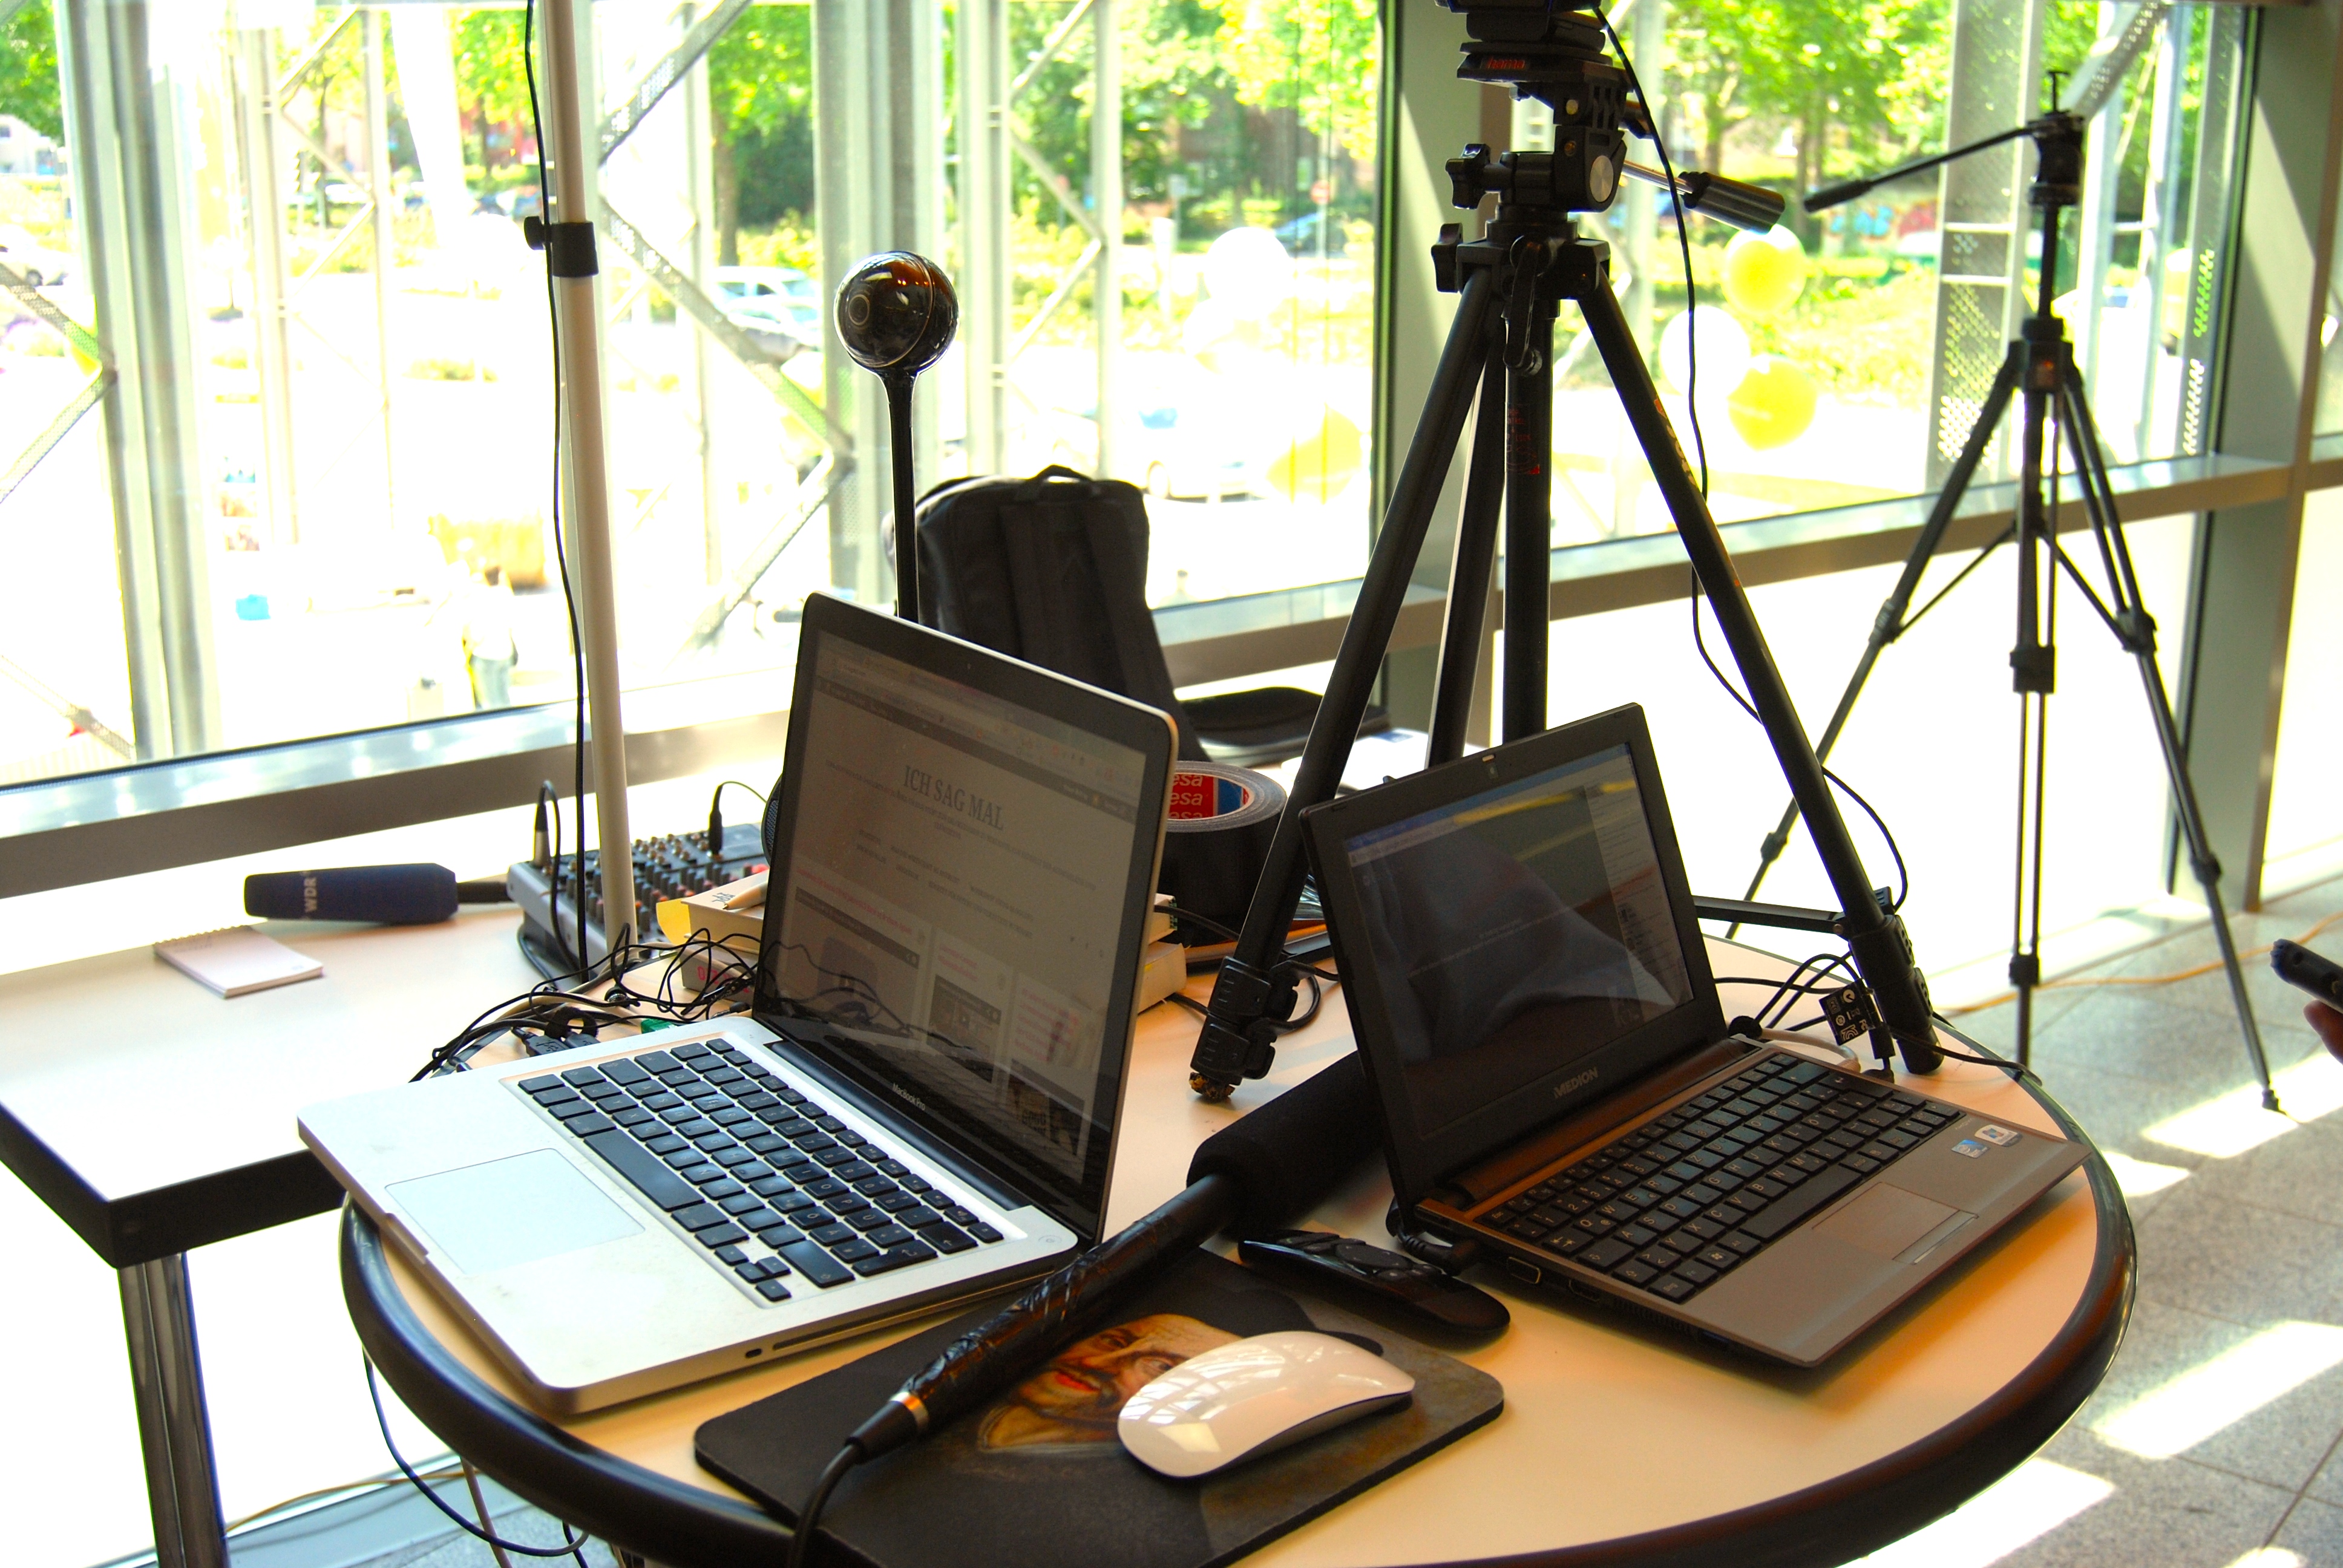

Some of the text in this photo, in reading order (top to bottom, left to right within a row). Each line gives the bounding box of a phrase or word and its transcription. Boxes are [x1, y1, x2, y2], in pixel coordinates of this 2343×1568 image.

[903, 765, 932, 797] ICH
[934, 779, 966, 812] SAG
[968, 794, 1004, 831] MAL
[1170, 792, 1204, 806] esa
[304, 877, 318, 913] WDR
[892, 1082, 926, 1111] MacBook Pro
[1553, 1067, 1599, 1099] MEDION
[1602, 1204, 1616, 1214] W
[1625, 1192, 1638, 1201] E
[1647, 1180, 1660, 1188] R
[1621, 1230, 1634, 1239] A
[1642, 1216, 1655, 1225] S
[1664, 1203, 1677, 1211] D
[1708, 1177, 1721, 1185] G
[1729, 1163, 1742, 1172] H
[1688, 1223, 1702, 1232] X
[1710, 1210, 1723, 1218] C
[1730, 1196, 1743, 1205] V
[1752, 1183, 1765, 1192] B
[1772, 1169, 1786, 1178] N
[1792, 1157, 1806, 1166] M
